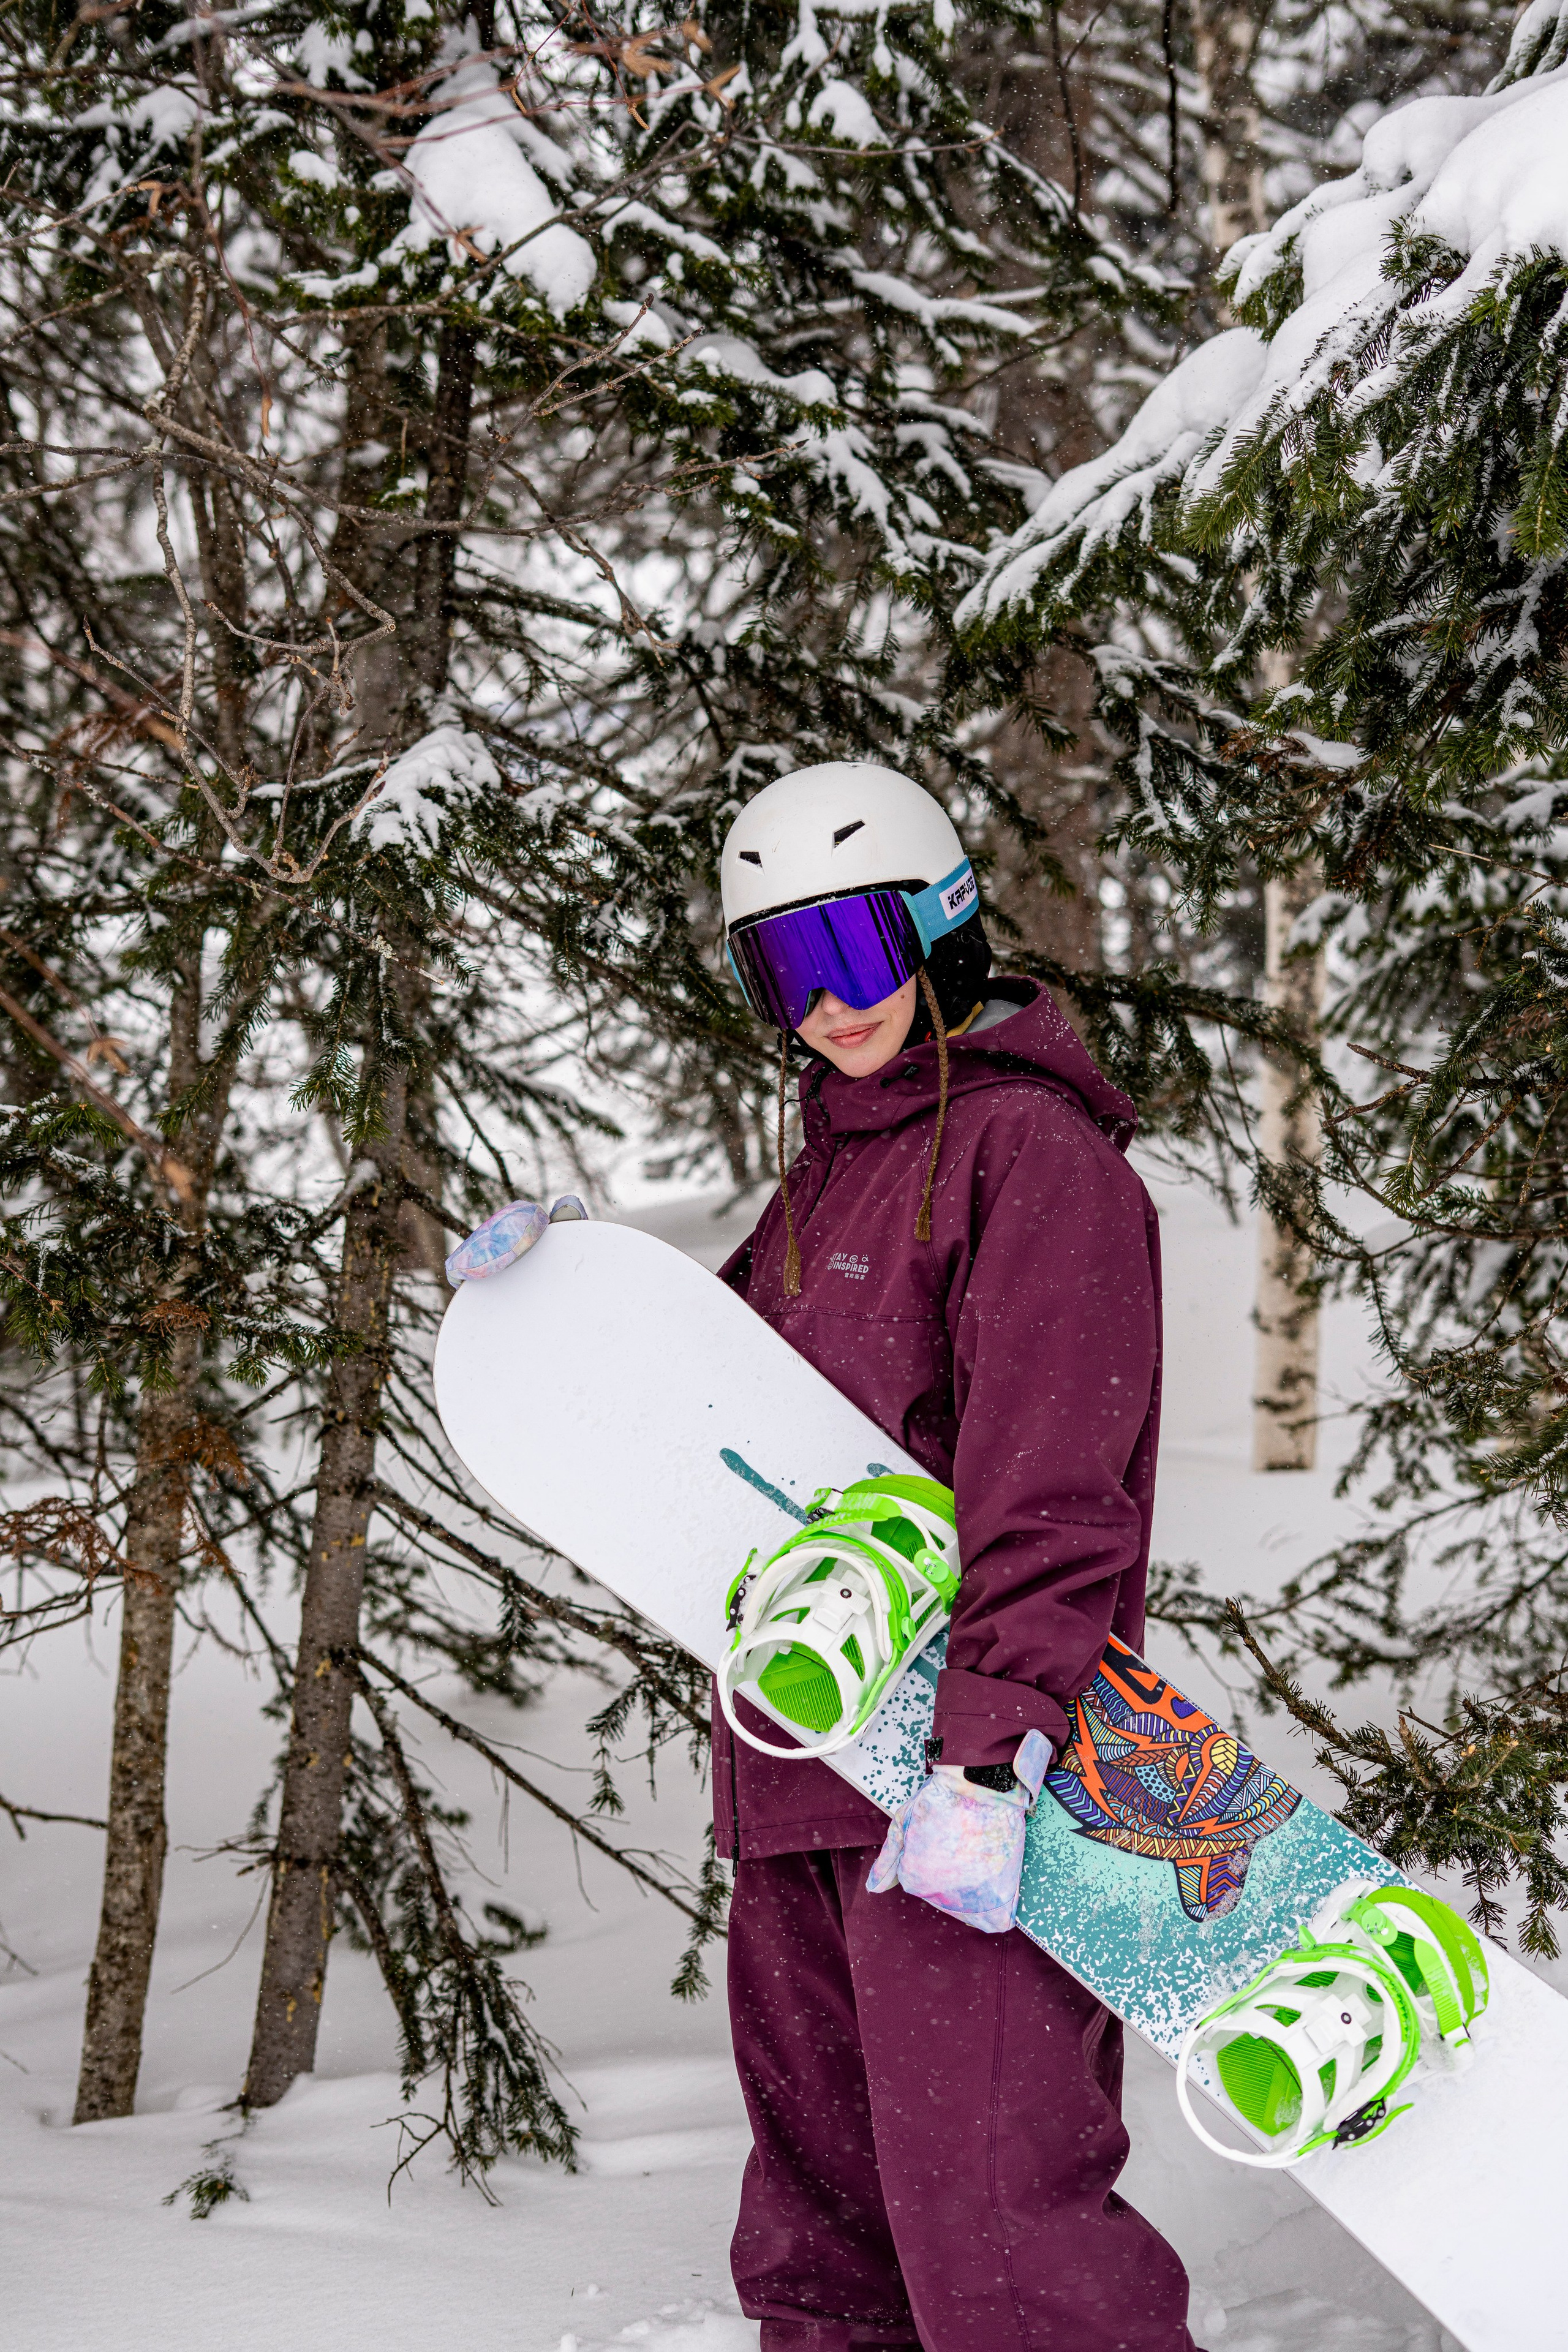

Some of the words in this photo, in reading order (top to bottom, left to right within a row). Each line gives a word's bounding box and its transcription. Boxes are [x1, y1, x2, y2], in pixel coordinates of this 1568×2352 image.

[830, 1253, 848, 1261] STAY
[833, 1261, 869, 1273] INSPIRED
[1015, 1920, 1041, 1945] NDEPENDENT
